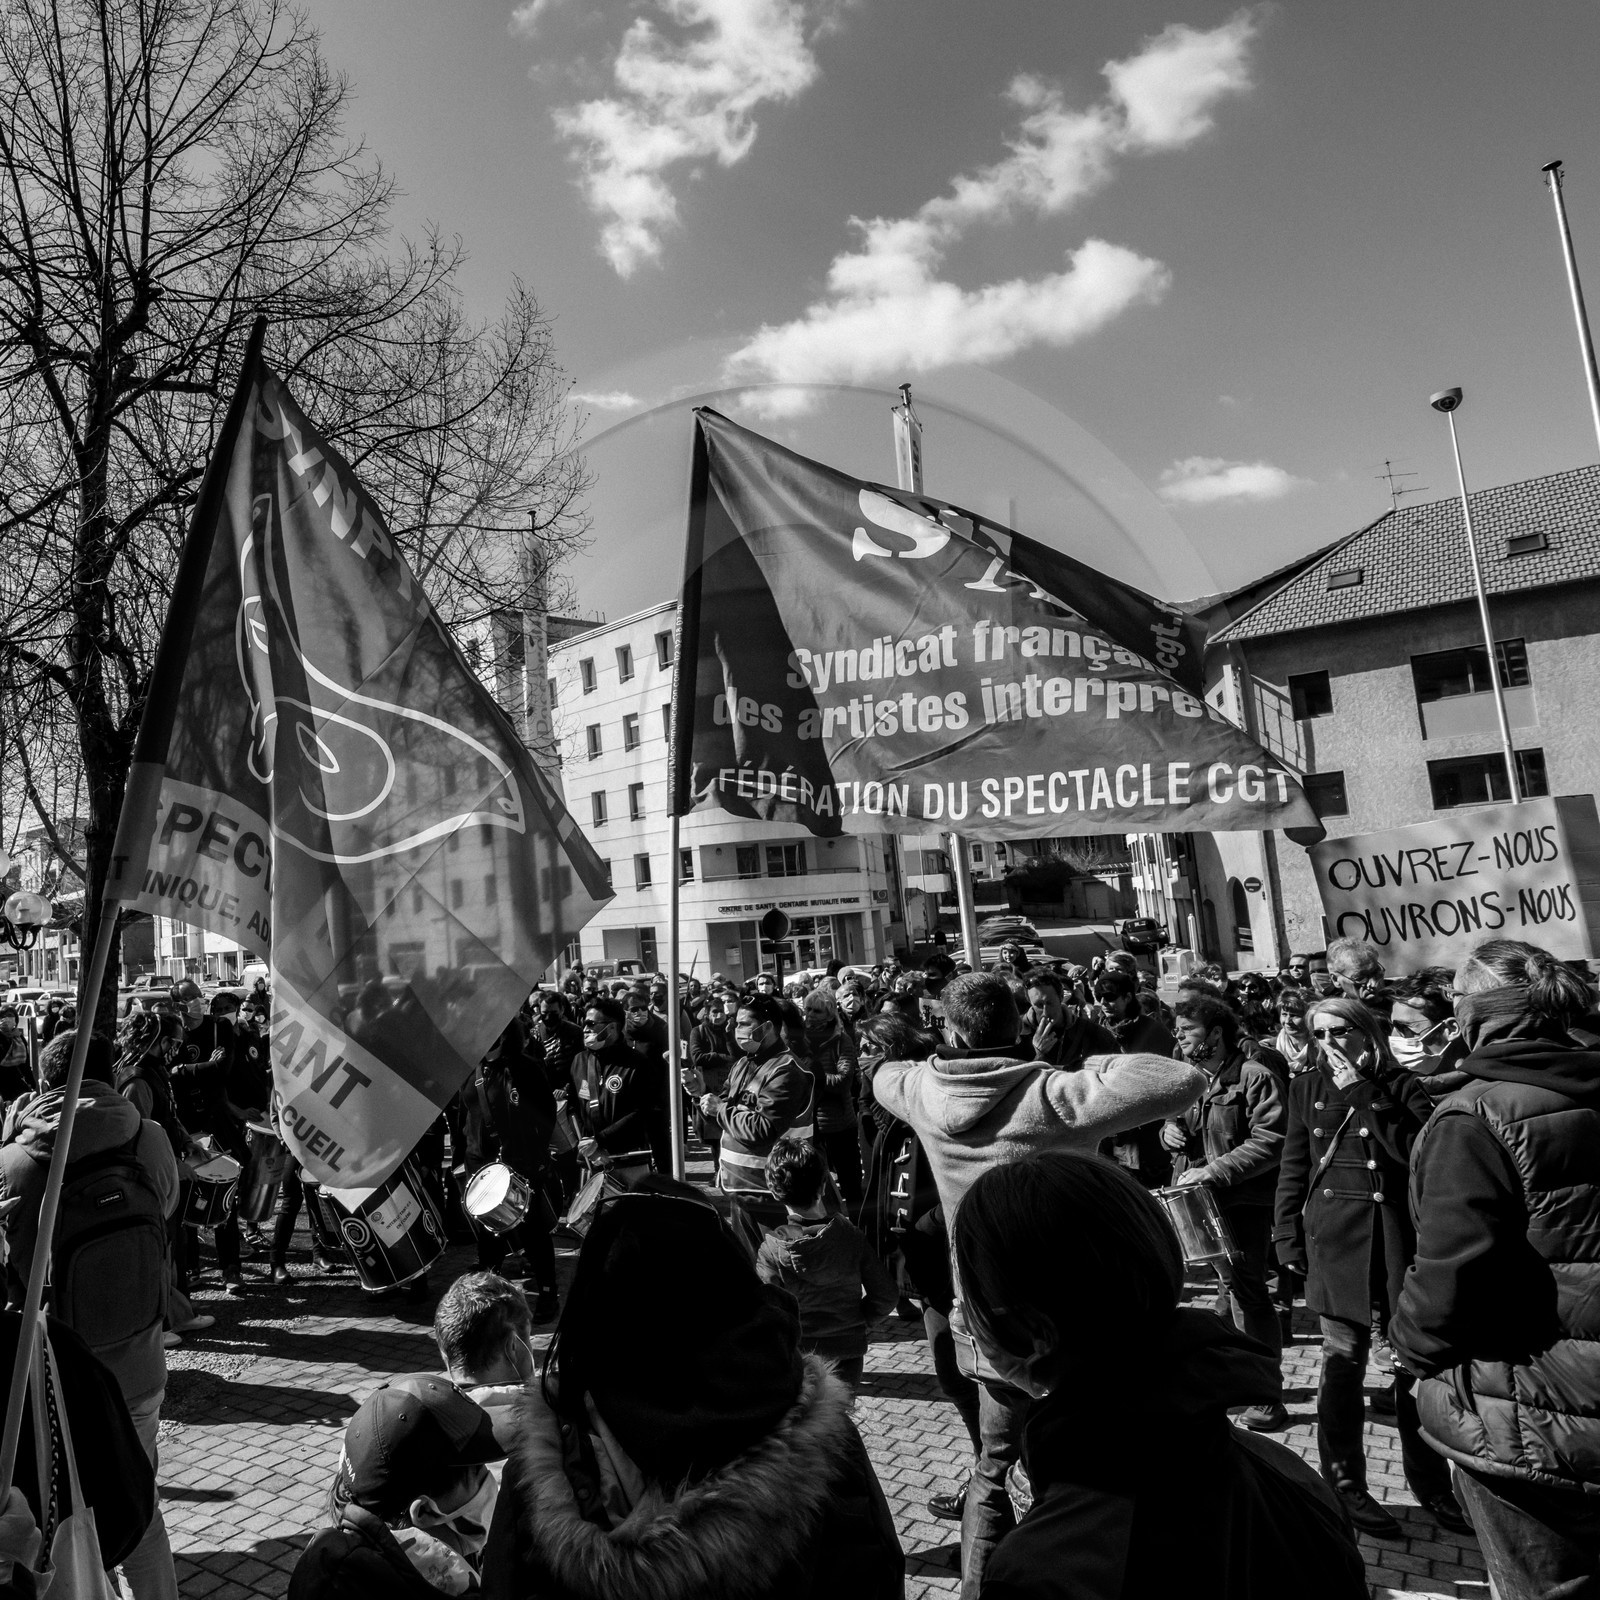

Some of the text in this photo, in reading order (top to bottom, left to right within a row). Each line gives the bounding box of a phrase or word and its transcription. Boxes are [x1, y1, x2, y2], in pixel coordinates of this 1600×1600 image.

[786, 621, 958, 695] Syndicat
[712, 685, 783, 733] des
[797, 686, 969, 741] artistes
[718, 760, 1292, 822] FÉDÉRATION DU SPECTACLE CGT
[1328, 825, 1559, 891] OUVREZ-NOUS
[246, 909, 272, 952] AD
[718, 904, 742, 913] CENTRE
[779, 900, 809, 909] DENTAIRE
[1336, 883, 1577, 946] OUVRONS-NOUS
